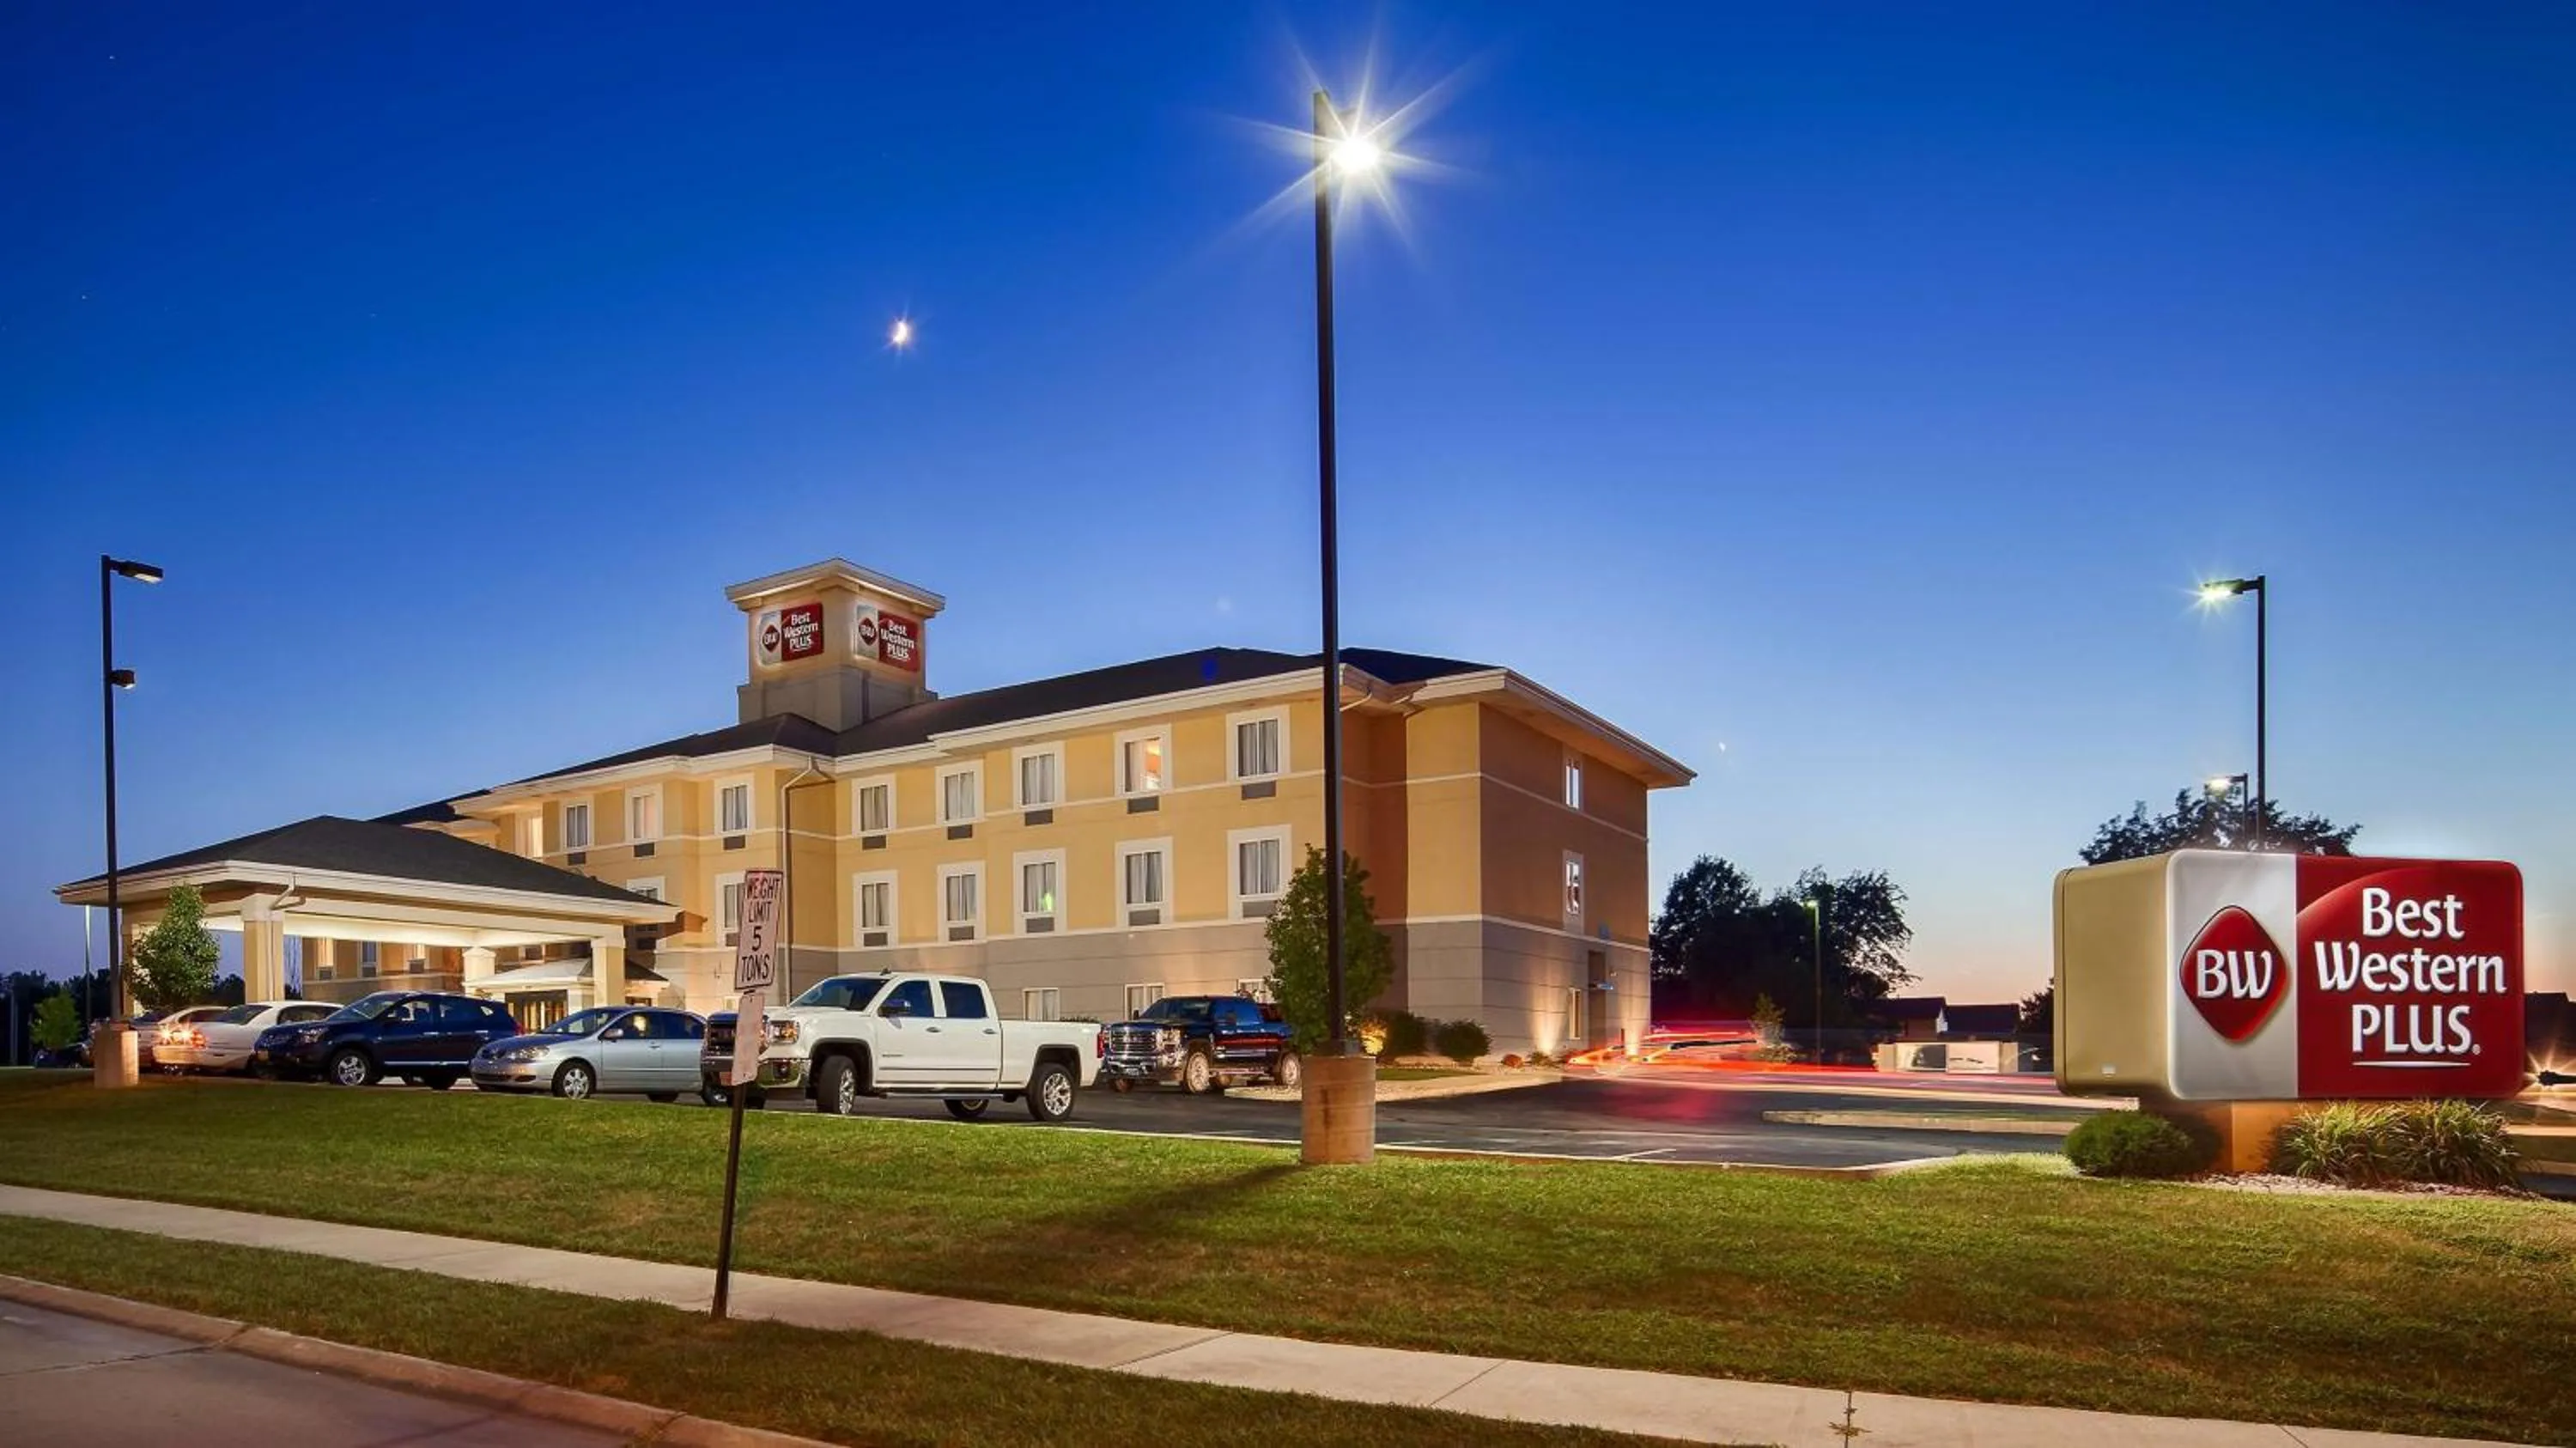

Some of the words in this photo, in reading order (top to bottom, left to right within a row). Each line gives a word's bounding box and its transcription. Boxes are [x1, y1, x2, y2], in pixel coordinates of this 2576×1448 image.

[791, 611, 811, 626] Best
[889, 620, 907, 636] Best
[783, 623, 819, 639] Western
[790, 635, 812, 650] PLUS
[881, 628, 914, 649] Western
[887, 642, 909, 659] PLUS
[746, 877, 781, 901] WEIGHT
[749, 901, 771, 923] LIMIT
[2362, 887, 2465, 939] Best
[752, 926, 762, 952] 5
[741, 953, 770, 983] TONS
[2196, 948, 2273, 1000] BW
[2314, 940, 2508, 994] Western
[2352, 1003, 2473, 1056] PLUS
